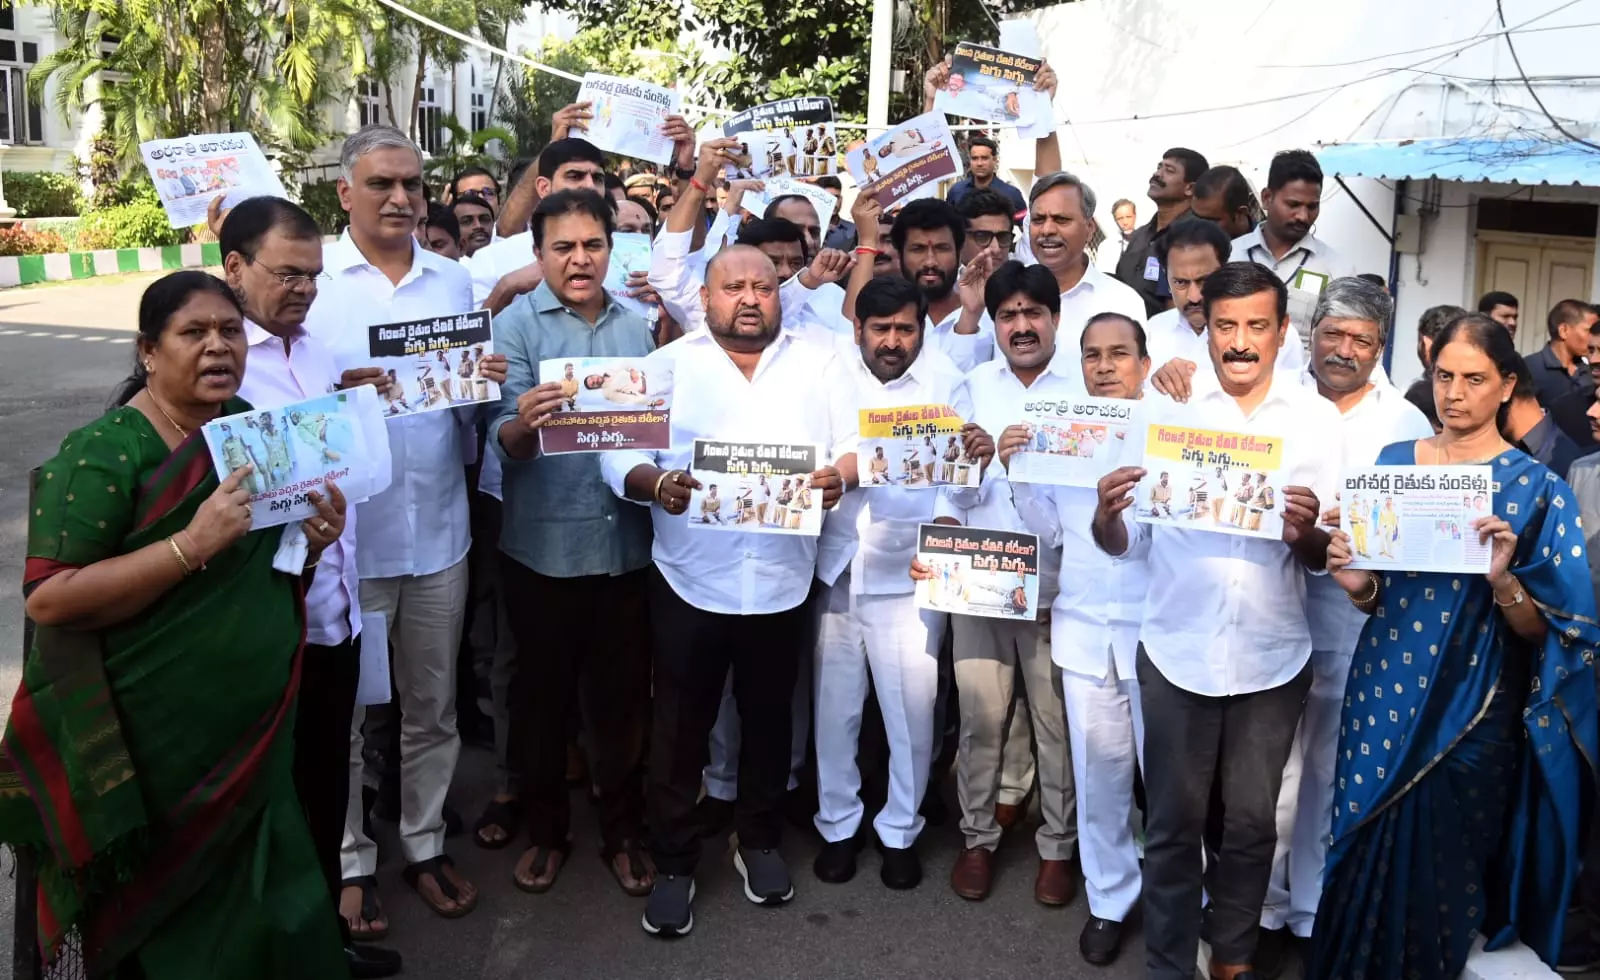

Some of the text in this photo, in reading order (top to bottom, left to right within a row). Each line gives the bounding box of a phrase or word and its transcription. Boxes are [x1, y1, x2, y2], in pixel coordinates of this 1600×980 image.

[200, 139, 247, 153] అరాచకం!
[379, 326, 406, 340] గిరిజన
[456, 314, 483, 330] బేడీలా?
[404, 340, 425, 357] సిగ్గు
[611, 415, 636, 426] రైతుకు
[639, 412, 668, 423] బేడీలా?
[1073, 403, 1130, 419] అరాచకం!
[577, 431, 599, 448] సిగ్గు
[892, 424, 912, 440] సిగ్గు
[1158, 429, 1185, 444] గిరిజన
[1186, 432, 1212, 449] రైతుల
[1241, 436, 1273, 454] బేడీలా?
[779, 445, 808, 460] బేడీలా?
[1182, 448, 1249, 471] సిగ్గు సిగ్గు....
[726, 460, 748, 477] సిగ్గు
[1346, 474, 1390, 494] లగచర్ల
[1393, 474, 1436, 494] రైతుకు
[270, 498, 291, 512] సిగ్గు
[925, 536, 953, 548] గిరిజన
[954, 538, 979, 552] రైతుల
[1005, 540, 1035, 556] బేడీలా?
[973, 554, 998, 576] సిగ్గు
